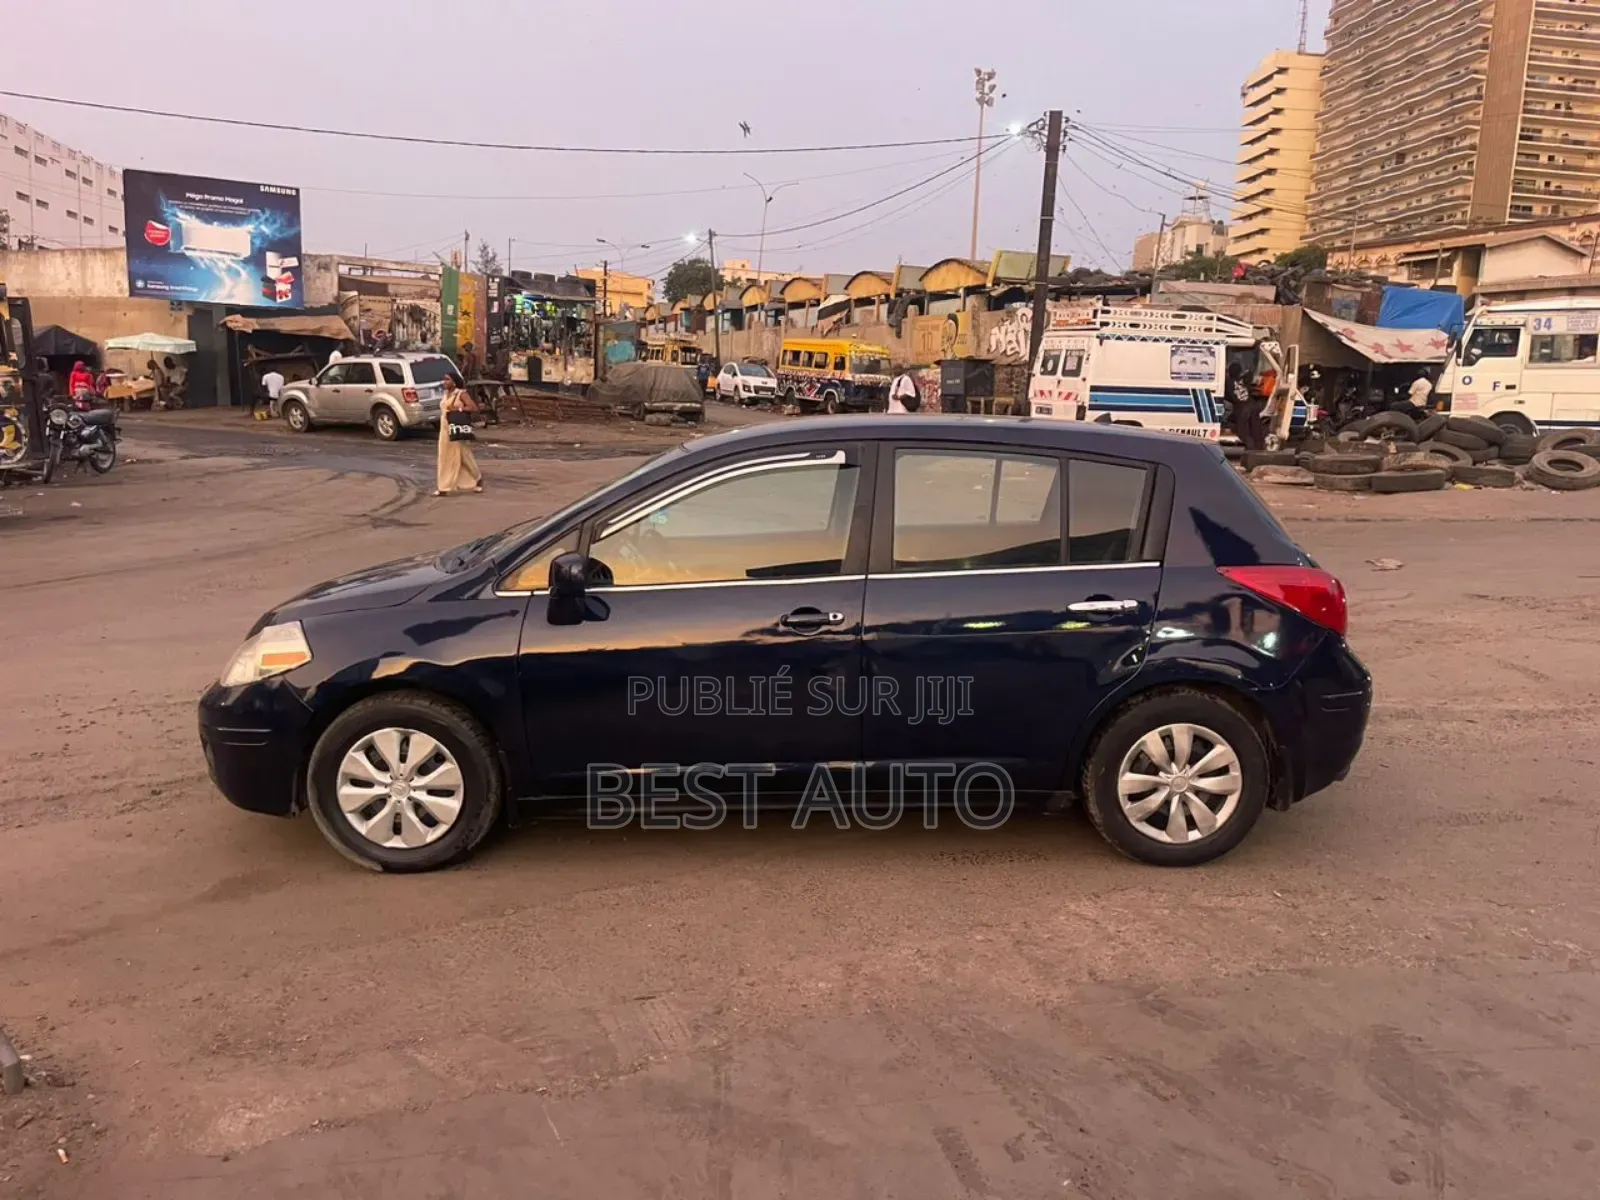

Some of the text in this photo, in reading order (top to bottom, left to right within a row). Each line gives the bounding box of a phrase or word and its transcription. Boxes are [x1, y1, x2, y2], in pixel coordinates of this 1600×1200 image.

[260, 185, 297, 196] SAMSUNG
[1533, 317, 1552, 331] 34
[1462, 375, 1501, 391] O F
